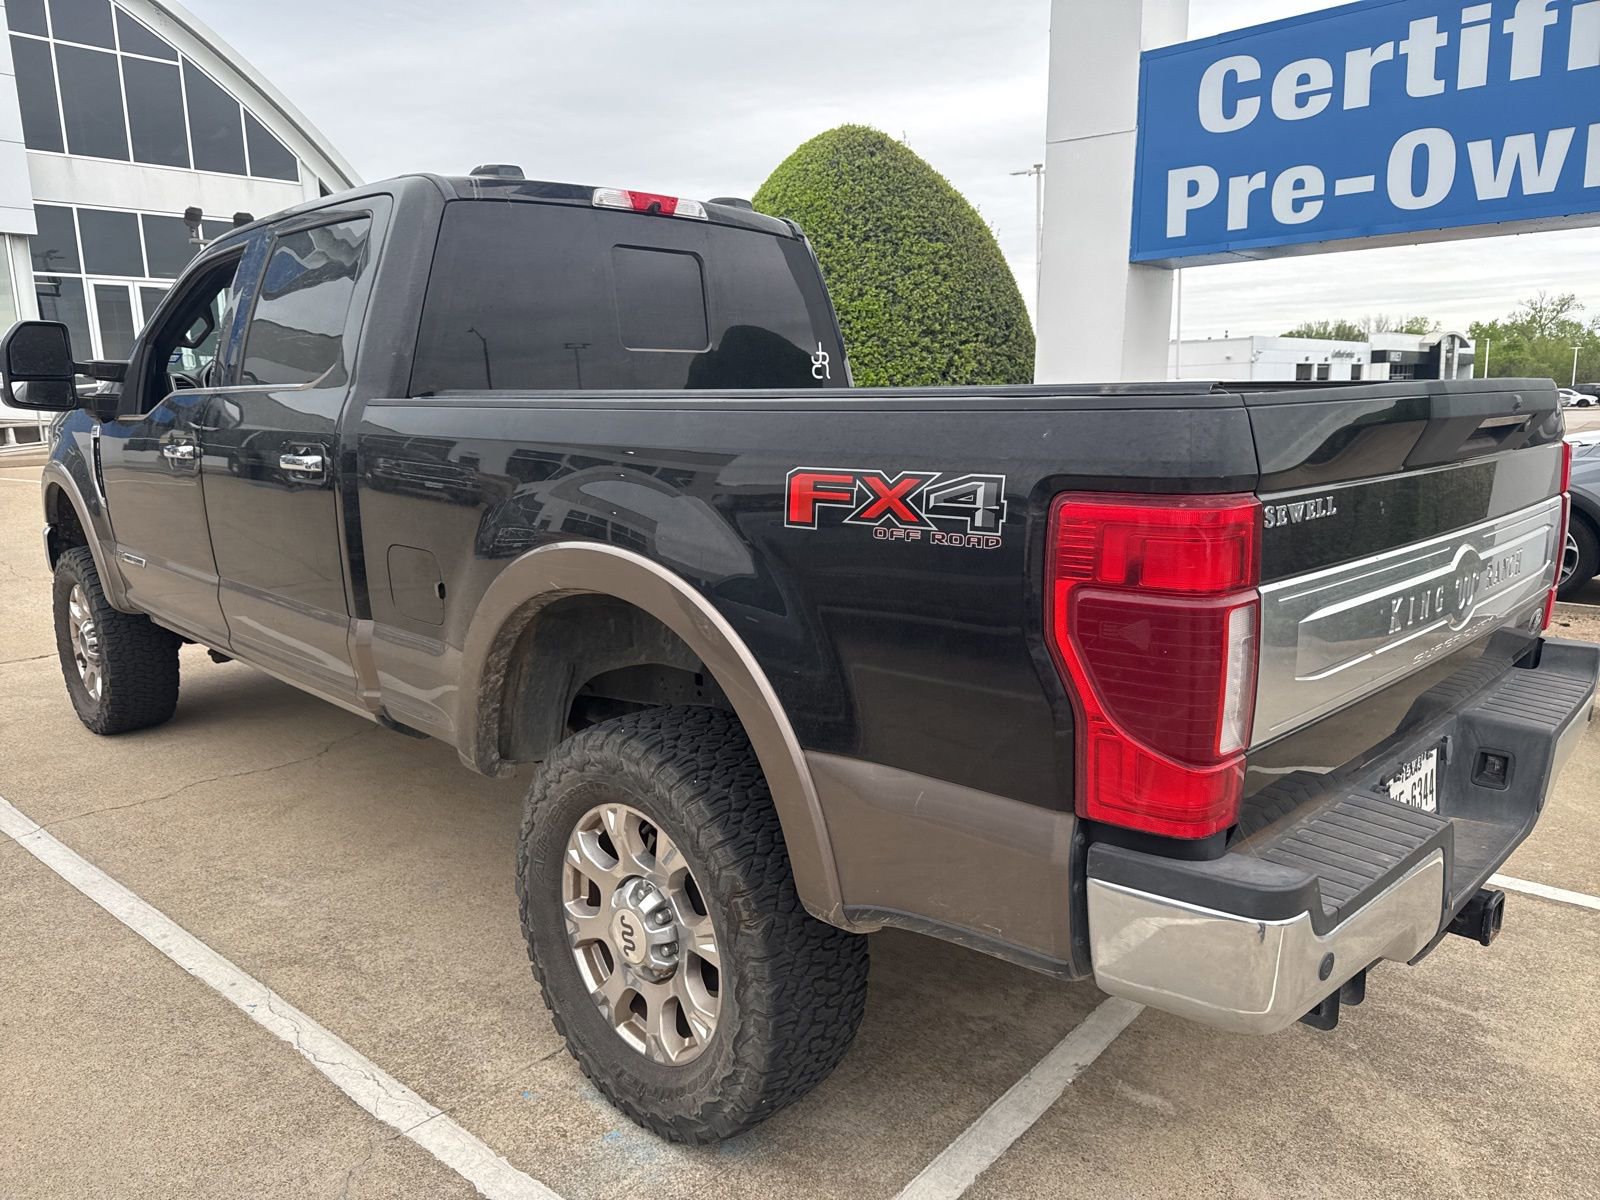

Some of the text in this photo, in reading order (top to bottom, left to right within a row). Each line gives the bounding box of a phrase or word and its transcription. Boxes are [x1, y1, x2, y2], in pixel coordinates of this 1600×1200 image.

[784, 466, 1007, 535] FX4
[1263, 496, 1337, 528] SEWELL
[873, 527, 1002, 549] OFF ROAD
[1389, 548, 1523, 634] KING RANCH
